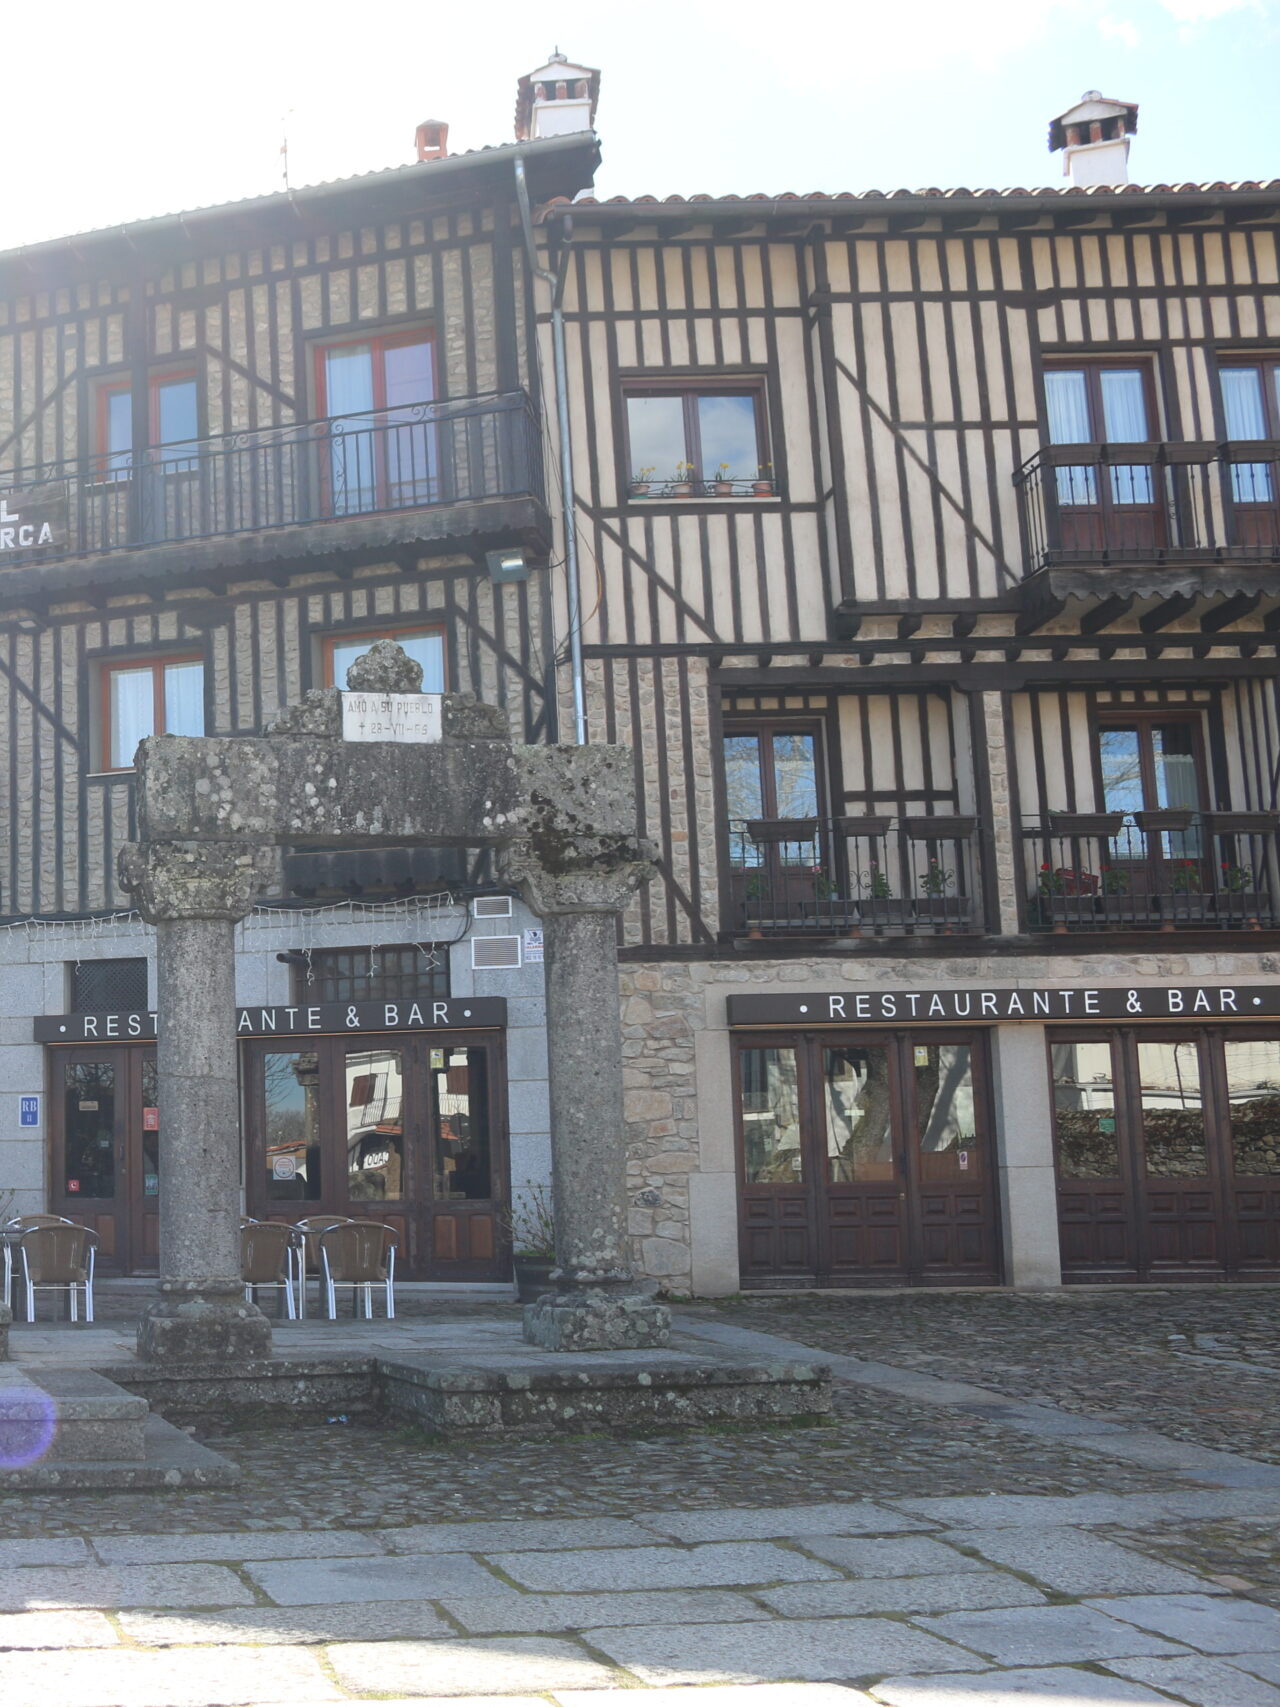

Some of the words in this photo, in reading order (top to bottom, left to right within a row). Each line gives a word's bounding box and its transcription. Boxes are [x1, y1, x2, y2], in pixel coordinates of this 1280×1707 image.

[371, 701, 377, 713] A
[381, 701, 393, 713] SU
[397, 702, 433, 714] PUEBLO
[829, 990, 1100, 1018] RESTAURANTE
[1126, 990, 1142, 1012] &
[1168, 988, 1238, 1012] BAR
[84, 1007, 321, 1037] RESTANTE
[345, 1005, 360, 1028] &
[384, 1002, 450, 1026] BAR
[22, 1100, 37, 1112] RB
